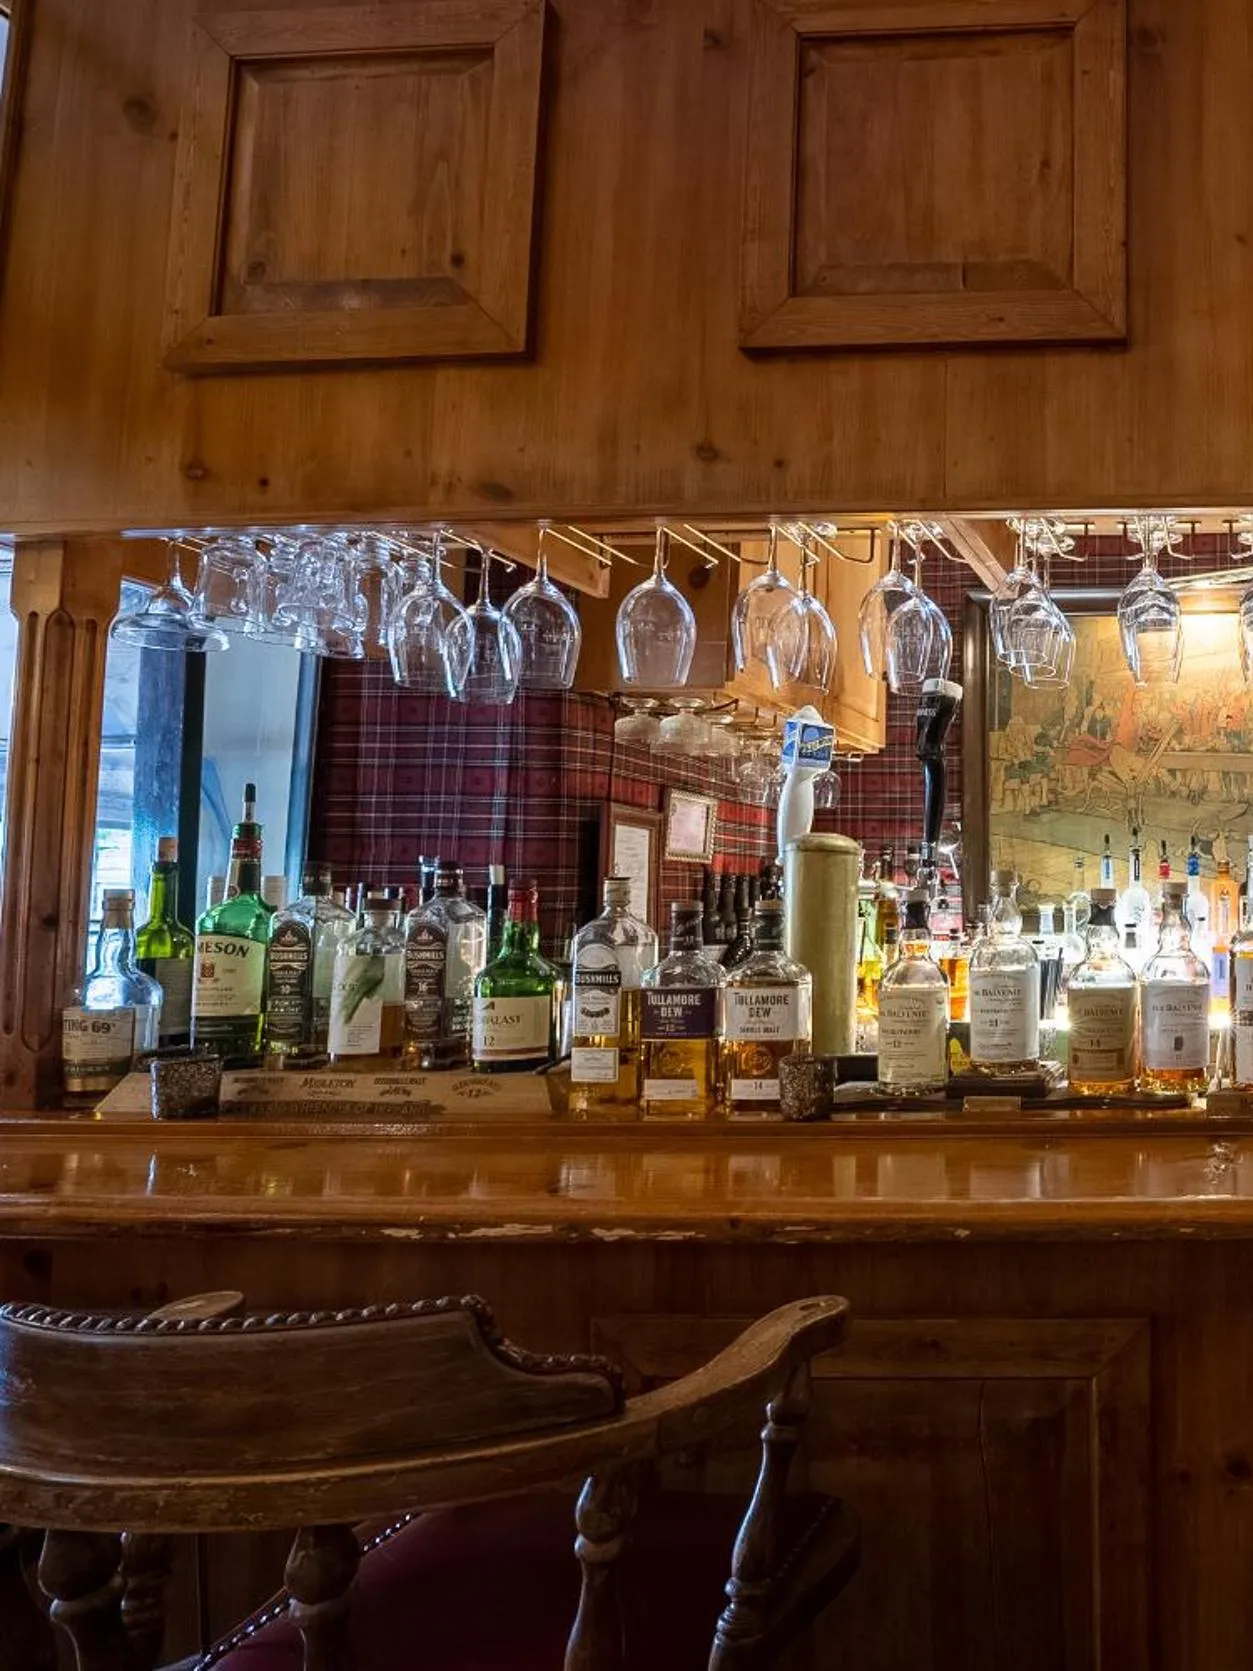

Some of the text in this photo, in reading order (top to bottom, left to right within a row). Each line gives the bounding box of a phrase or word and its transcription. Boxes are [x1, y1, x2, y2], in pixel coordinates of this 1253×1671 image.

[647, 992, 701, 1006] TULLAMORE
[734, 992, 790, 1006] TULLAMORE
[660, 1007, 683, 1017] DEW
[748, 1007, 772, 1018] DEW
